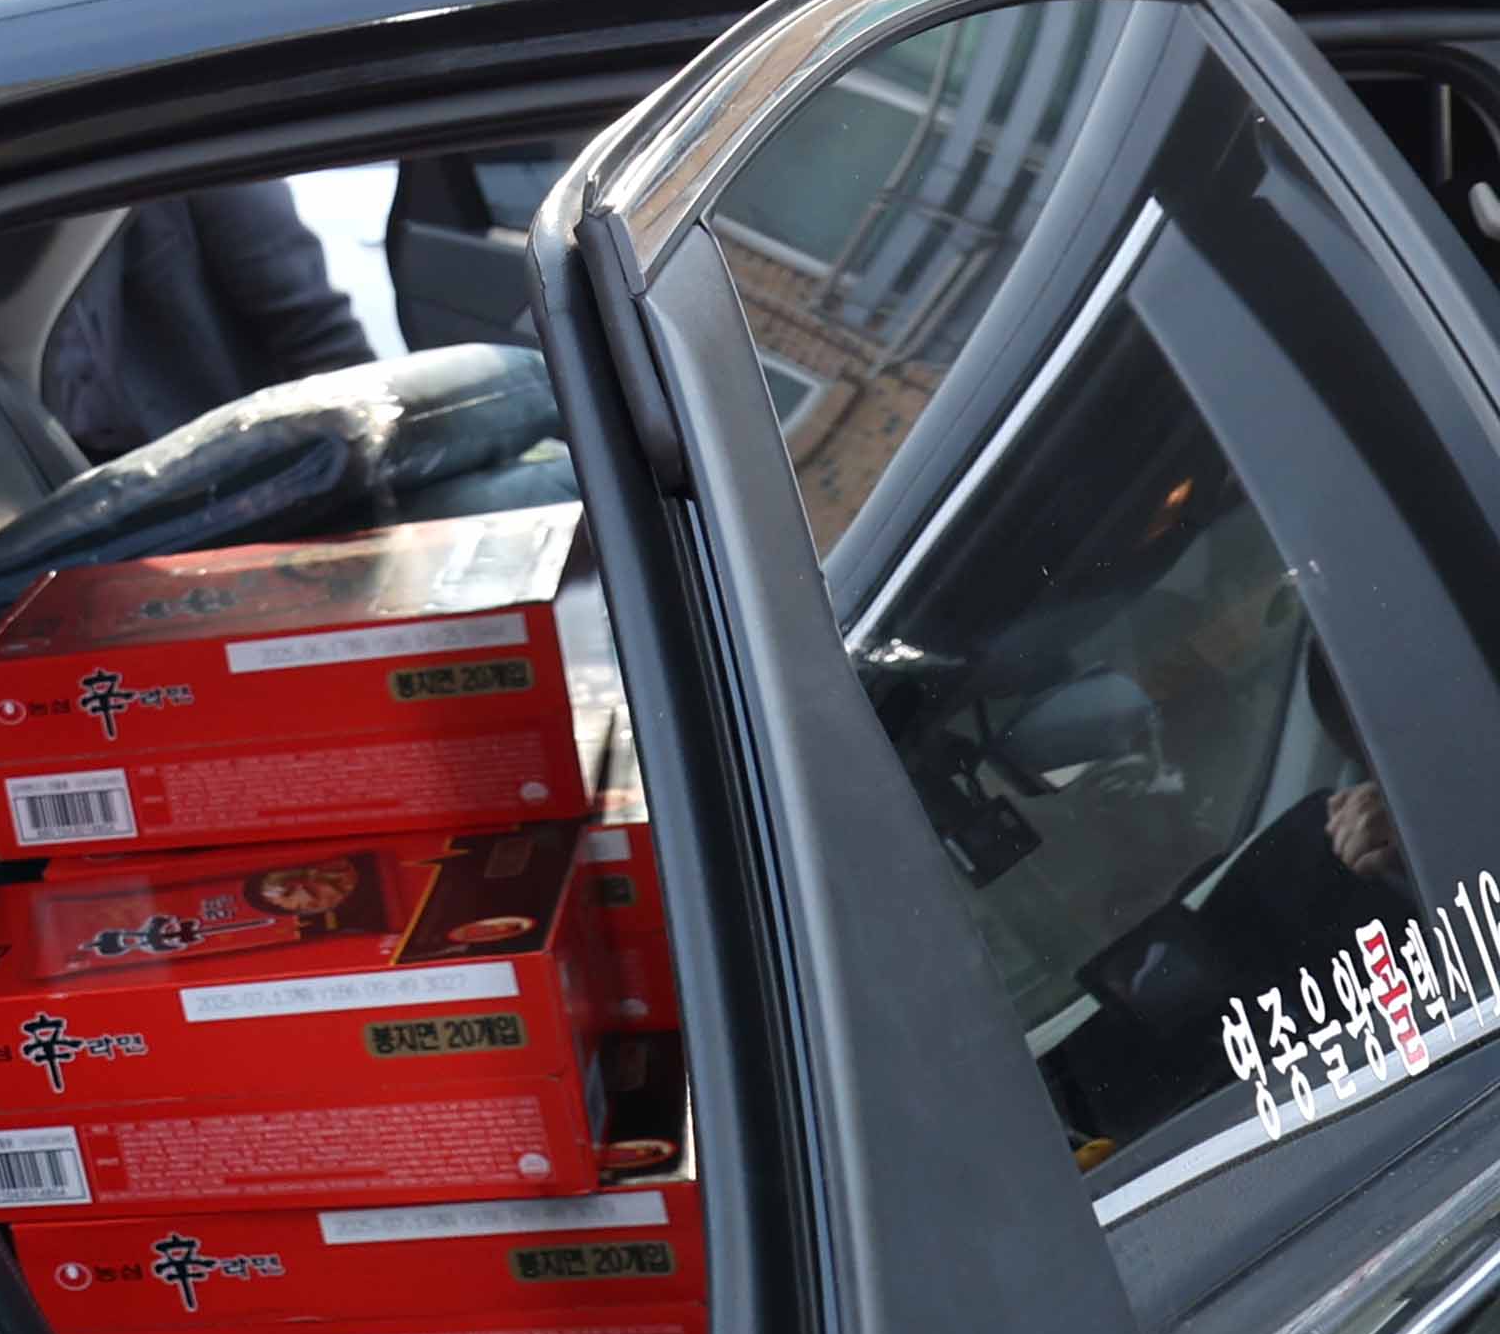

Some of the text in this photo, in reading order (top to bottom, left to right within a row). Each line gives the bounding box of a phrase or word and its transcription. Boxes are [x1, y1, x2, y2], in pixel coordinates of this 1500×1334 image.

[84, 1034, 148, 1058] 라면
[370, 1015, 522, 1054] 봉지면 20개입
